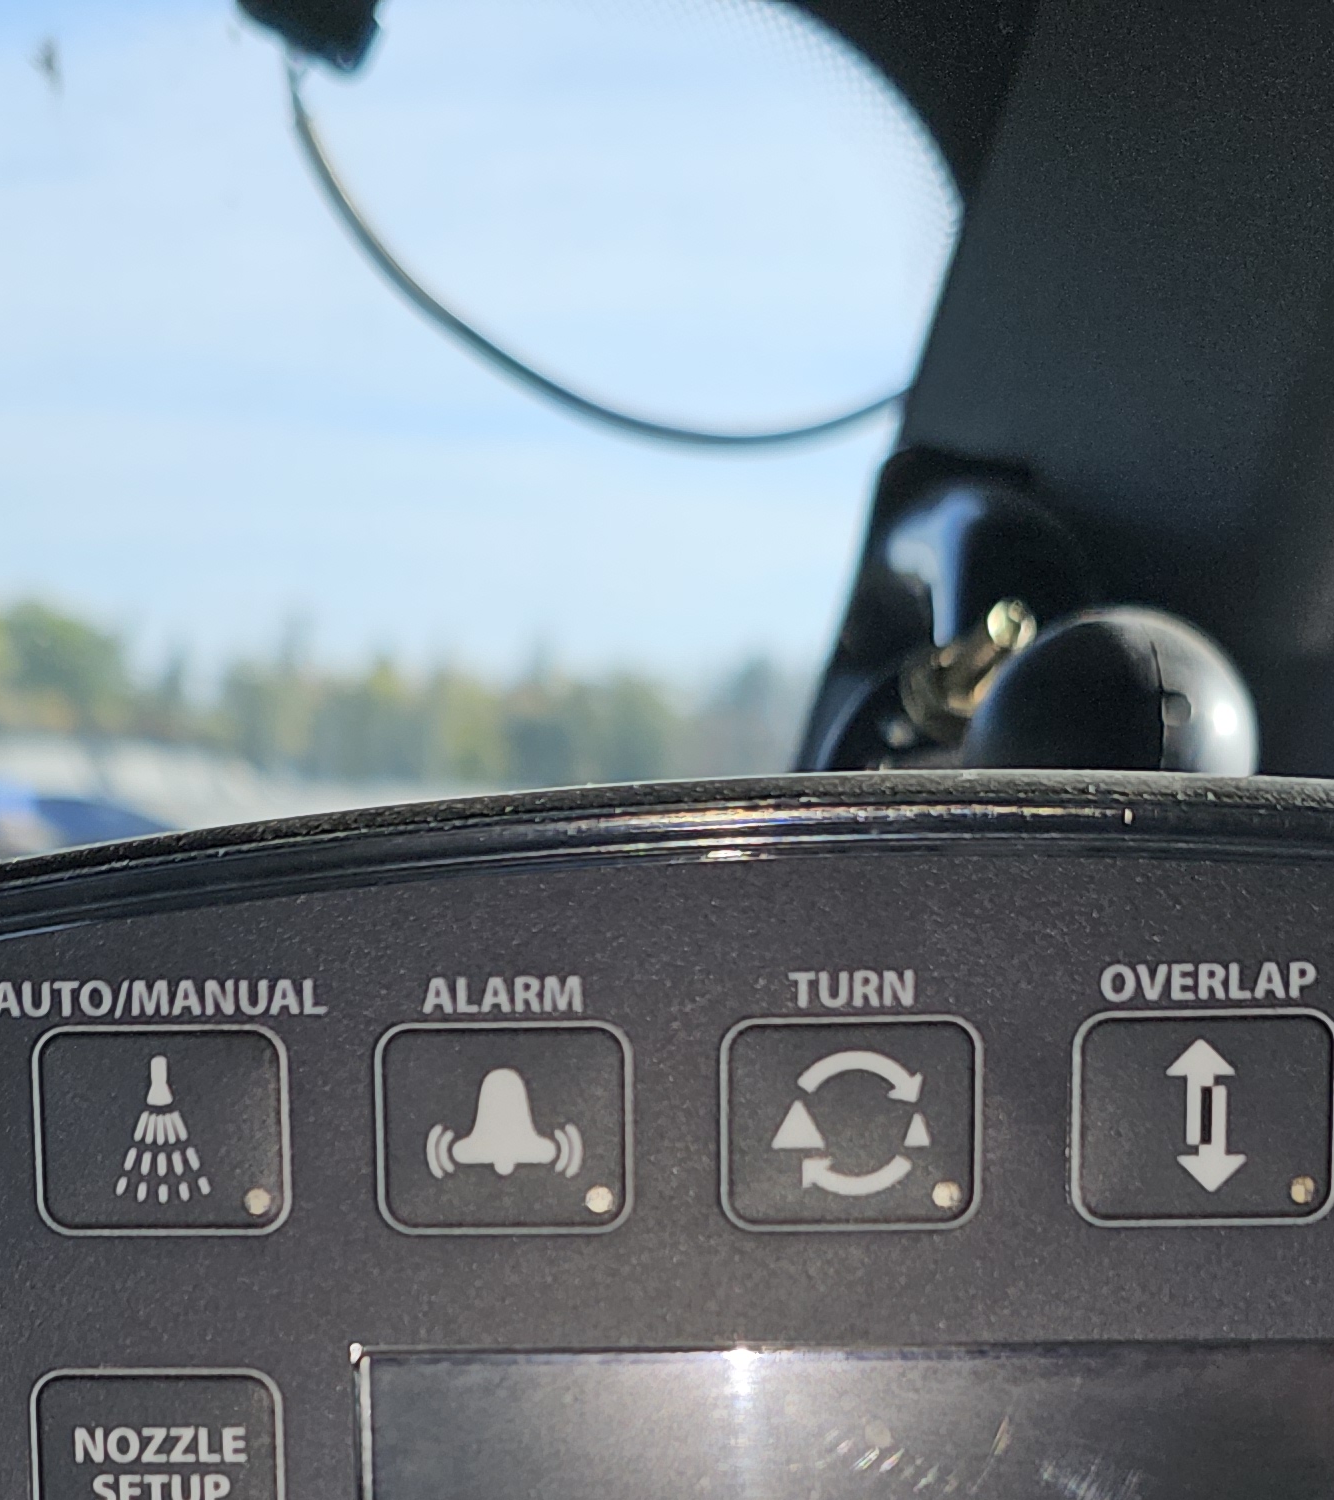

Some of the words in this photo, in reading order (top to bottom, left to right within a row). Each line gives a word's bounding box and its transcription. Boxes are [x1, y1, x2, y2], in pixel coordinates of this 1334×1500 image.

[422, 975, 584, 1015] ALARM
[787, 968, 916, 1010] TURN
[1100, 961, 1318, 1003] OVERLAP
[73, 1425, 249, 1465] NOZZLE
